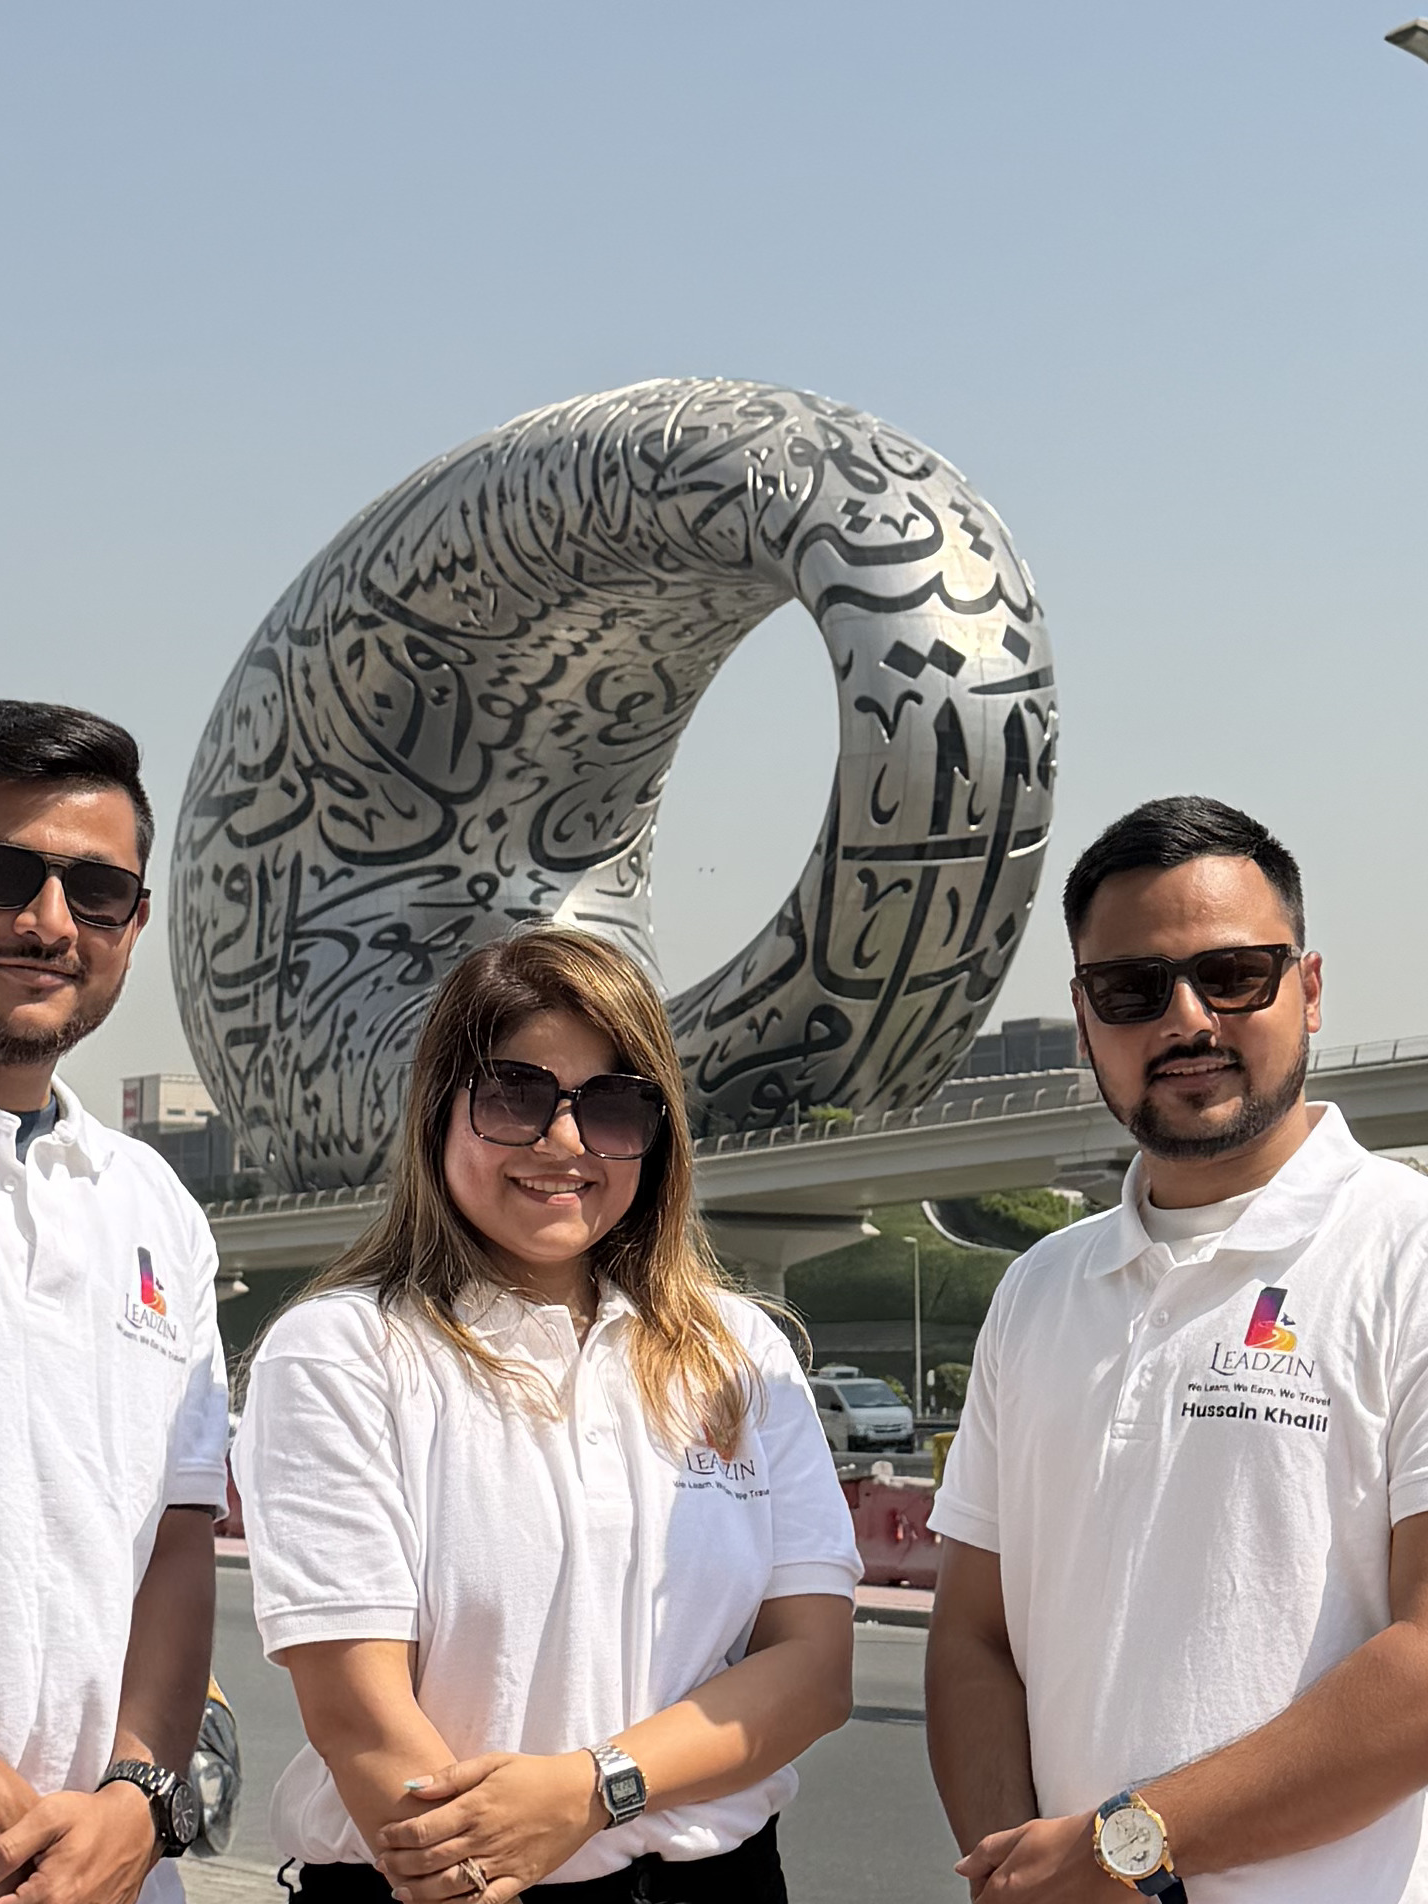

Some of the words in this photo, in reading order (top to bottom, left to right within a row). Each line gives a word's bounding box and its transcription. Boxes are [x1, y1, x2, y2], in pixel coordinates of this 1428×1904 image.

[1233, 1382, 1248, 1393] We
[1280, 1387, 1295, 1399] We
[1299, 1391, 1331, 1407] Travel
[1181, 1401, 1257, 1420] Hussain
[1264, 1406, 1329, 1432] Khalil
